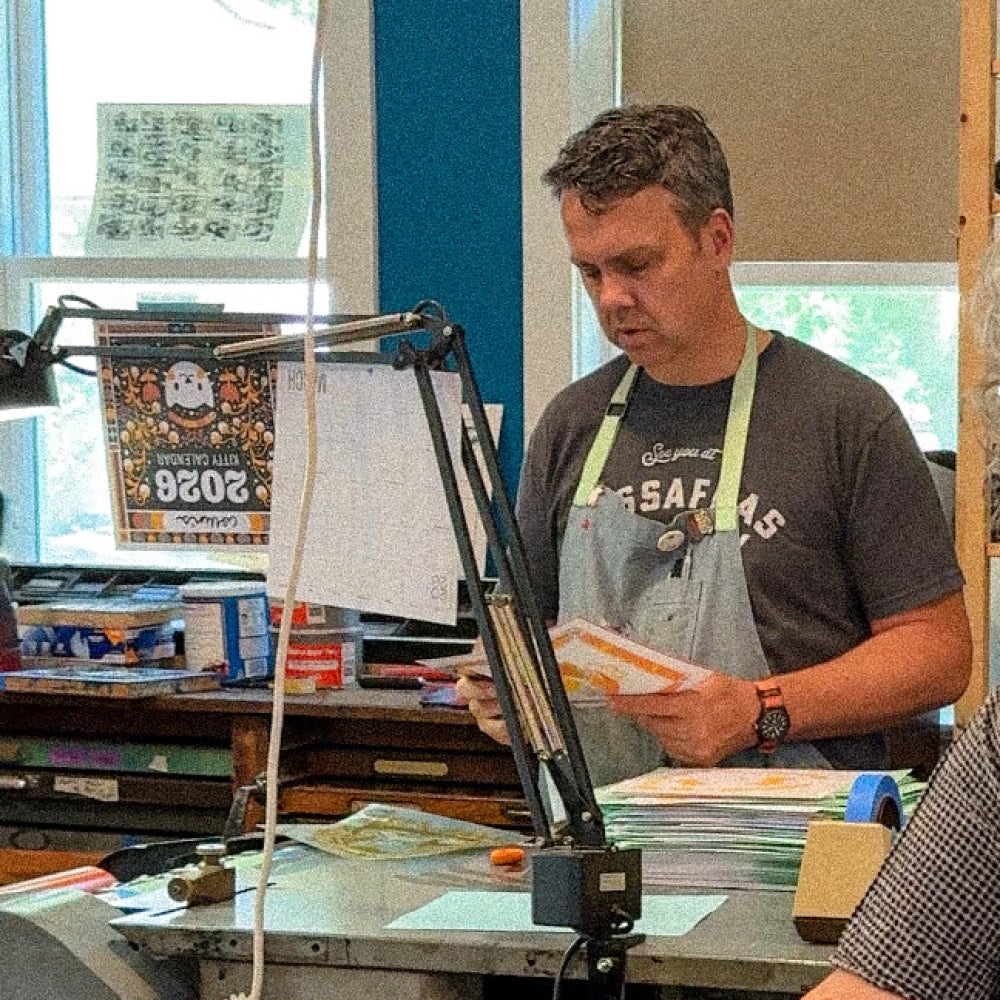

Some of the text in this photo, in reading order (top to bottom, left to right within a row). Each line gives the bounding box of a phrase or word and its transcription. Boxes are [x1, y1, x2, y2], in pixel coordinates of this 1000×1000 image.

[156, 452, 239, 467] KITTY CALENDAR
[642, 443, 723, 466] See you at
[155, 468, 250, 504] 2026
